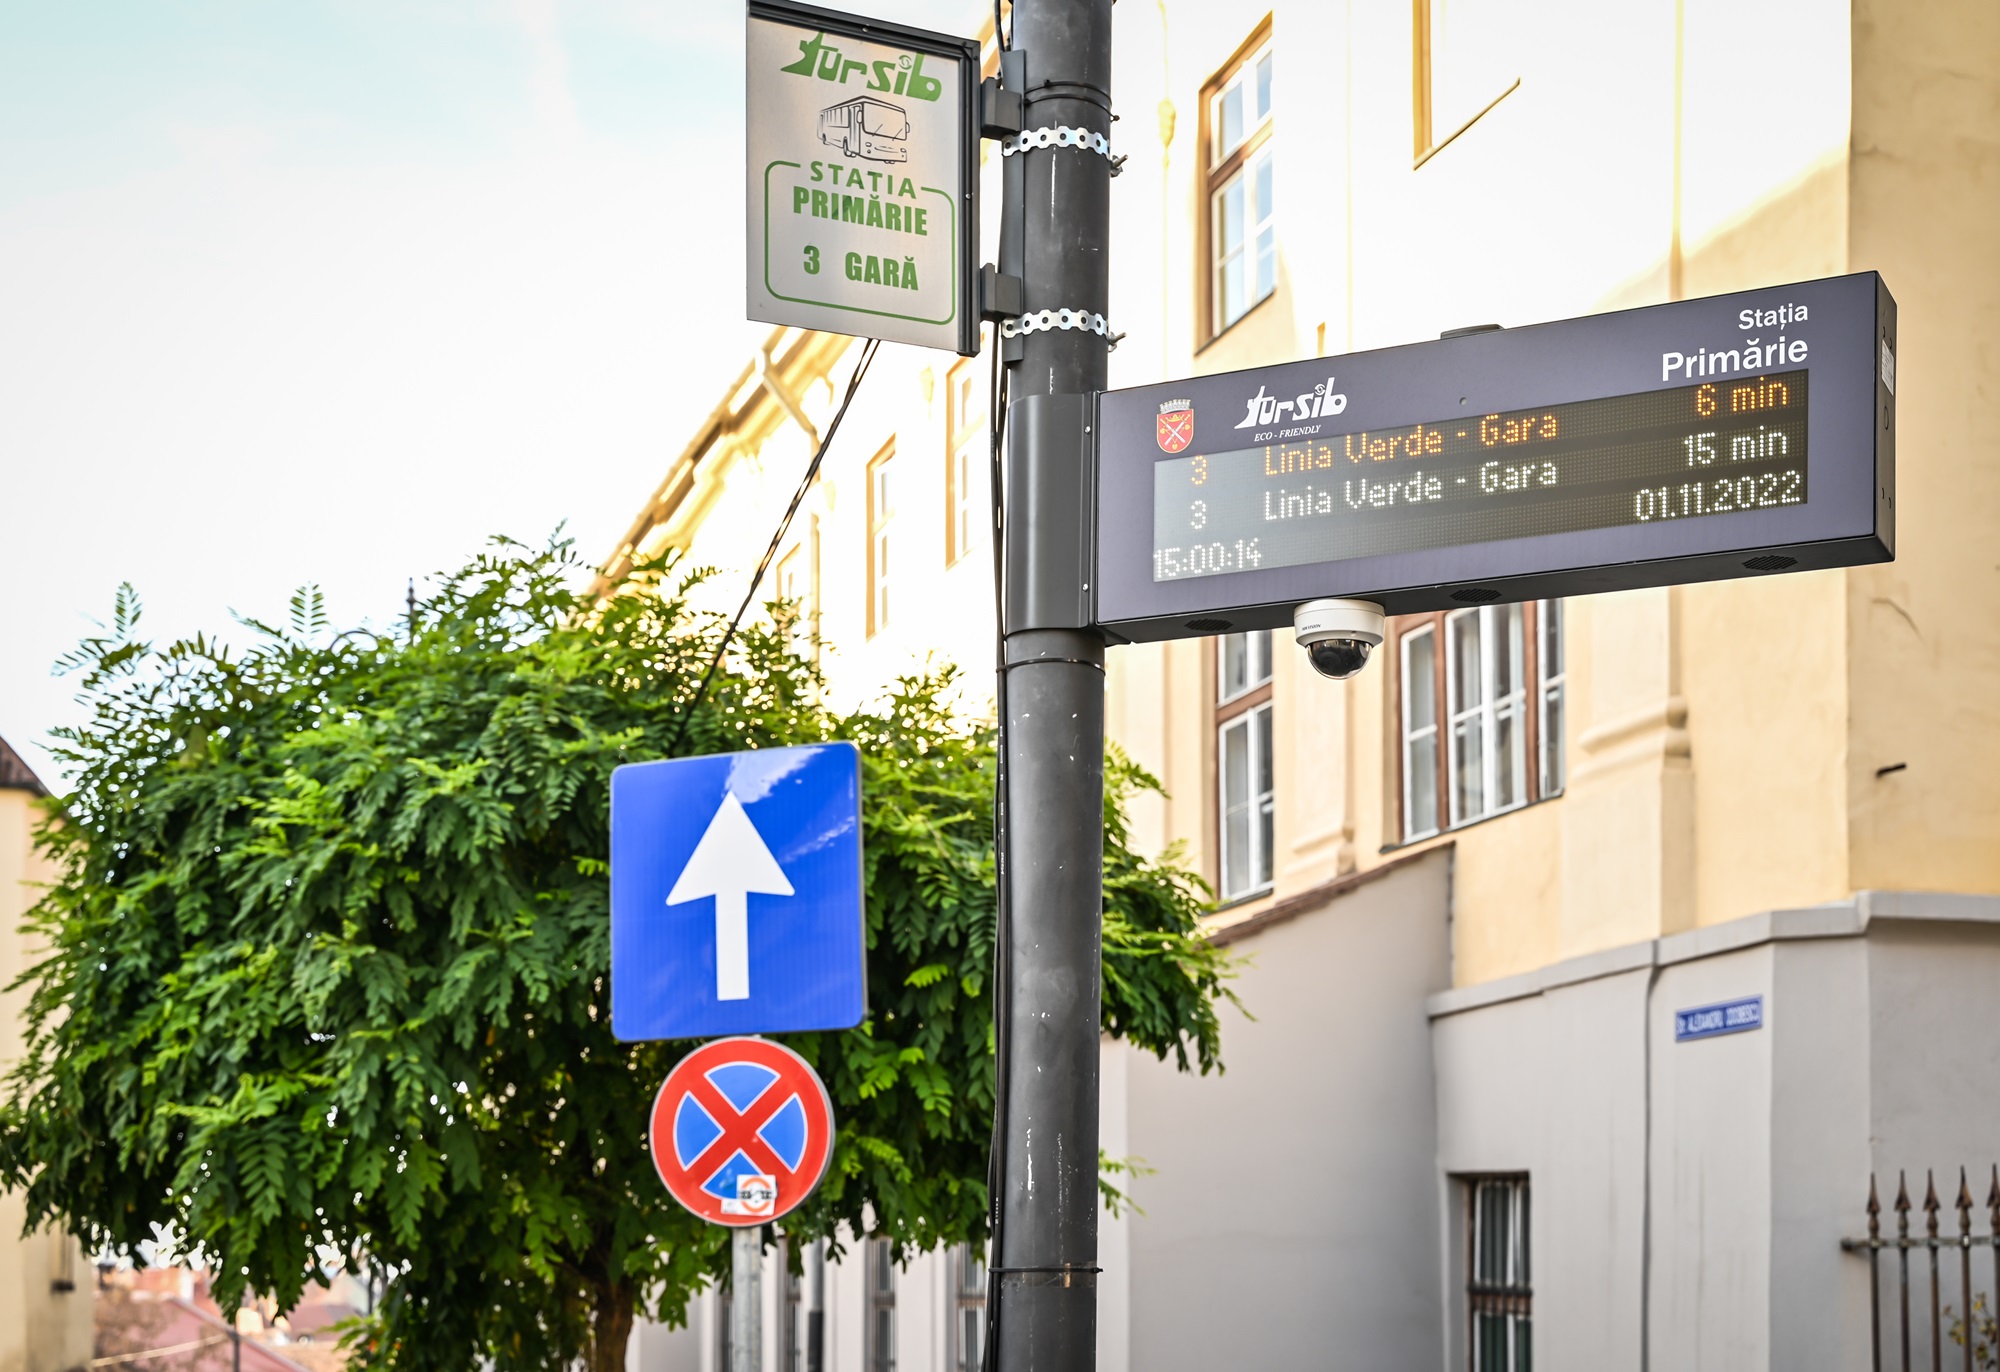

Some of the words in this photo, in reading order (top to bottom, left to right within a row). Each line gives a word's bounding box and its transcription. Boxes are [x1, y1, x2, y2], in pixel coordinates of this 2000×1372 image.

[793, 185, 928, 236] PRIMĂRIE
[803, 245, 821, 275] 3
[845, 252, 919, 291] GARĂ
[1738, 303, 1809, 330] Stația
[1662, 336, 1809, 382] Primărie
[1190, 455, 1207, 485] 3
[1265, 440, 1332, 476] Linia
[1345, 425, 1442, 464] Verde
[1481, 413, 1557, 446] Gara
[1696, 384, 1716, 416] 6
[1732, 376, 1788, 412] min
[1254, 431, 1273, 442] ECO
[1279, 424, 1321, 438] FRIENDLY
[1190, 500, 1207, 529] 3
[1265, 486, 1332, 521] Linia
[1345, 471, 1442, 509] Verde
[1481, 461, 1557, 494] Gara
[1684, 431, 1716, 467] 15
[1732, 425, 1788, 461] min
[1636, 470, 1801, 521] 01.11.2022
[1153, 537, 1262, 578] 15:00:14
